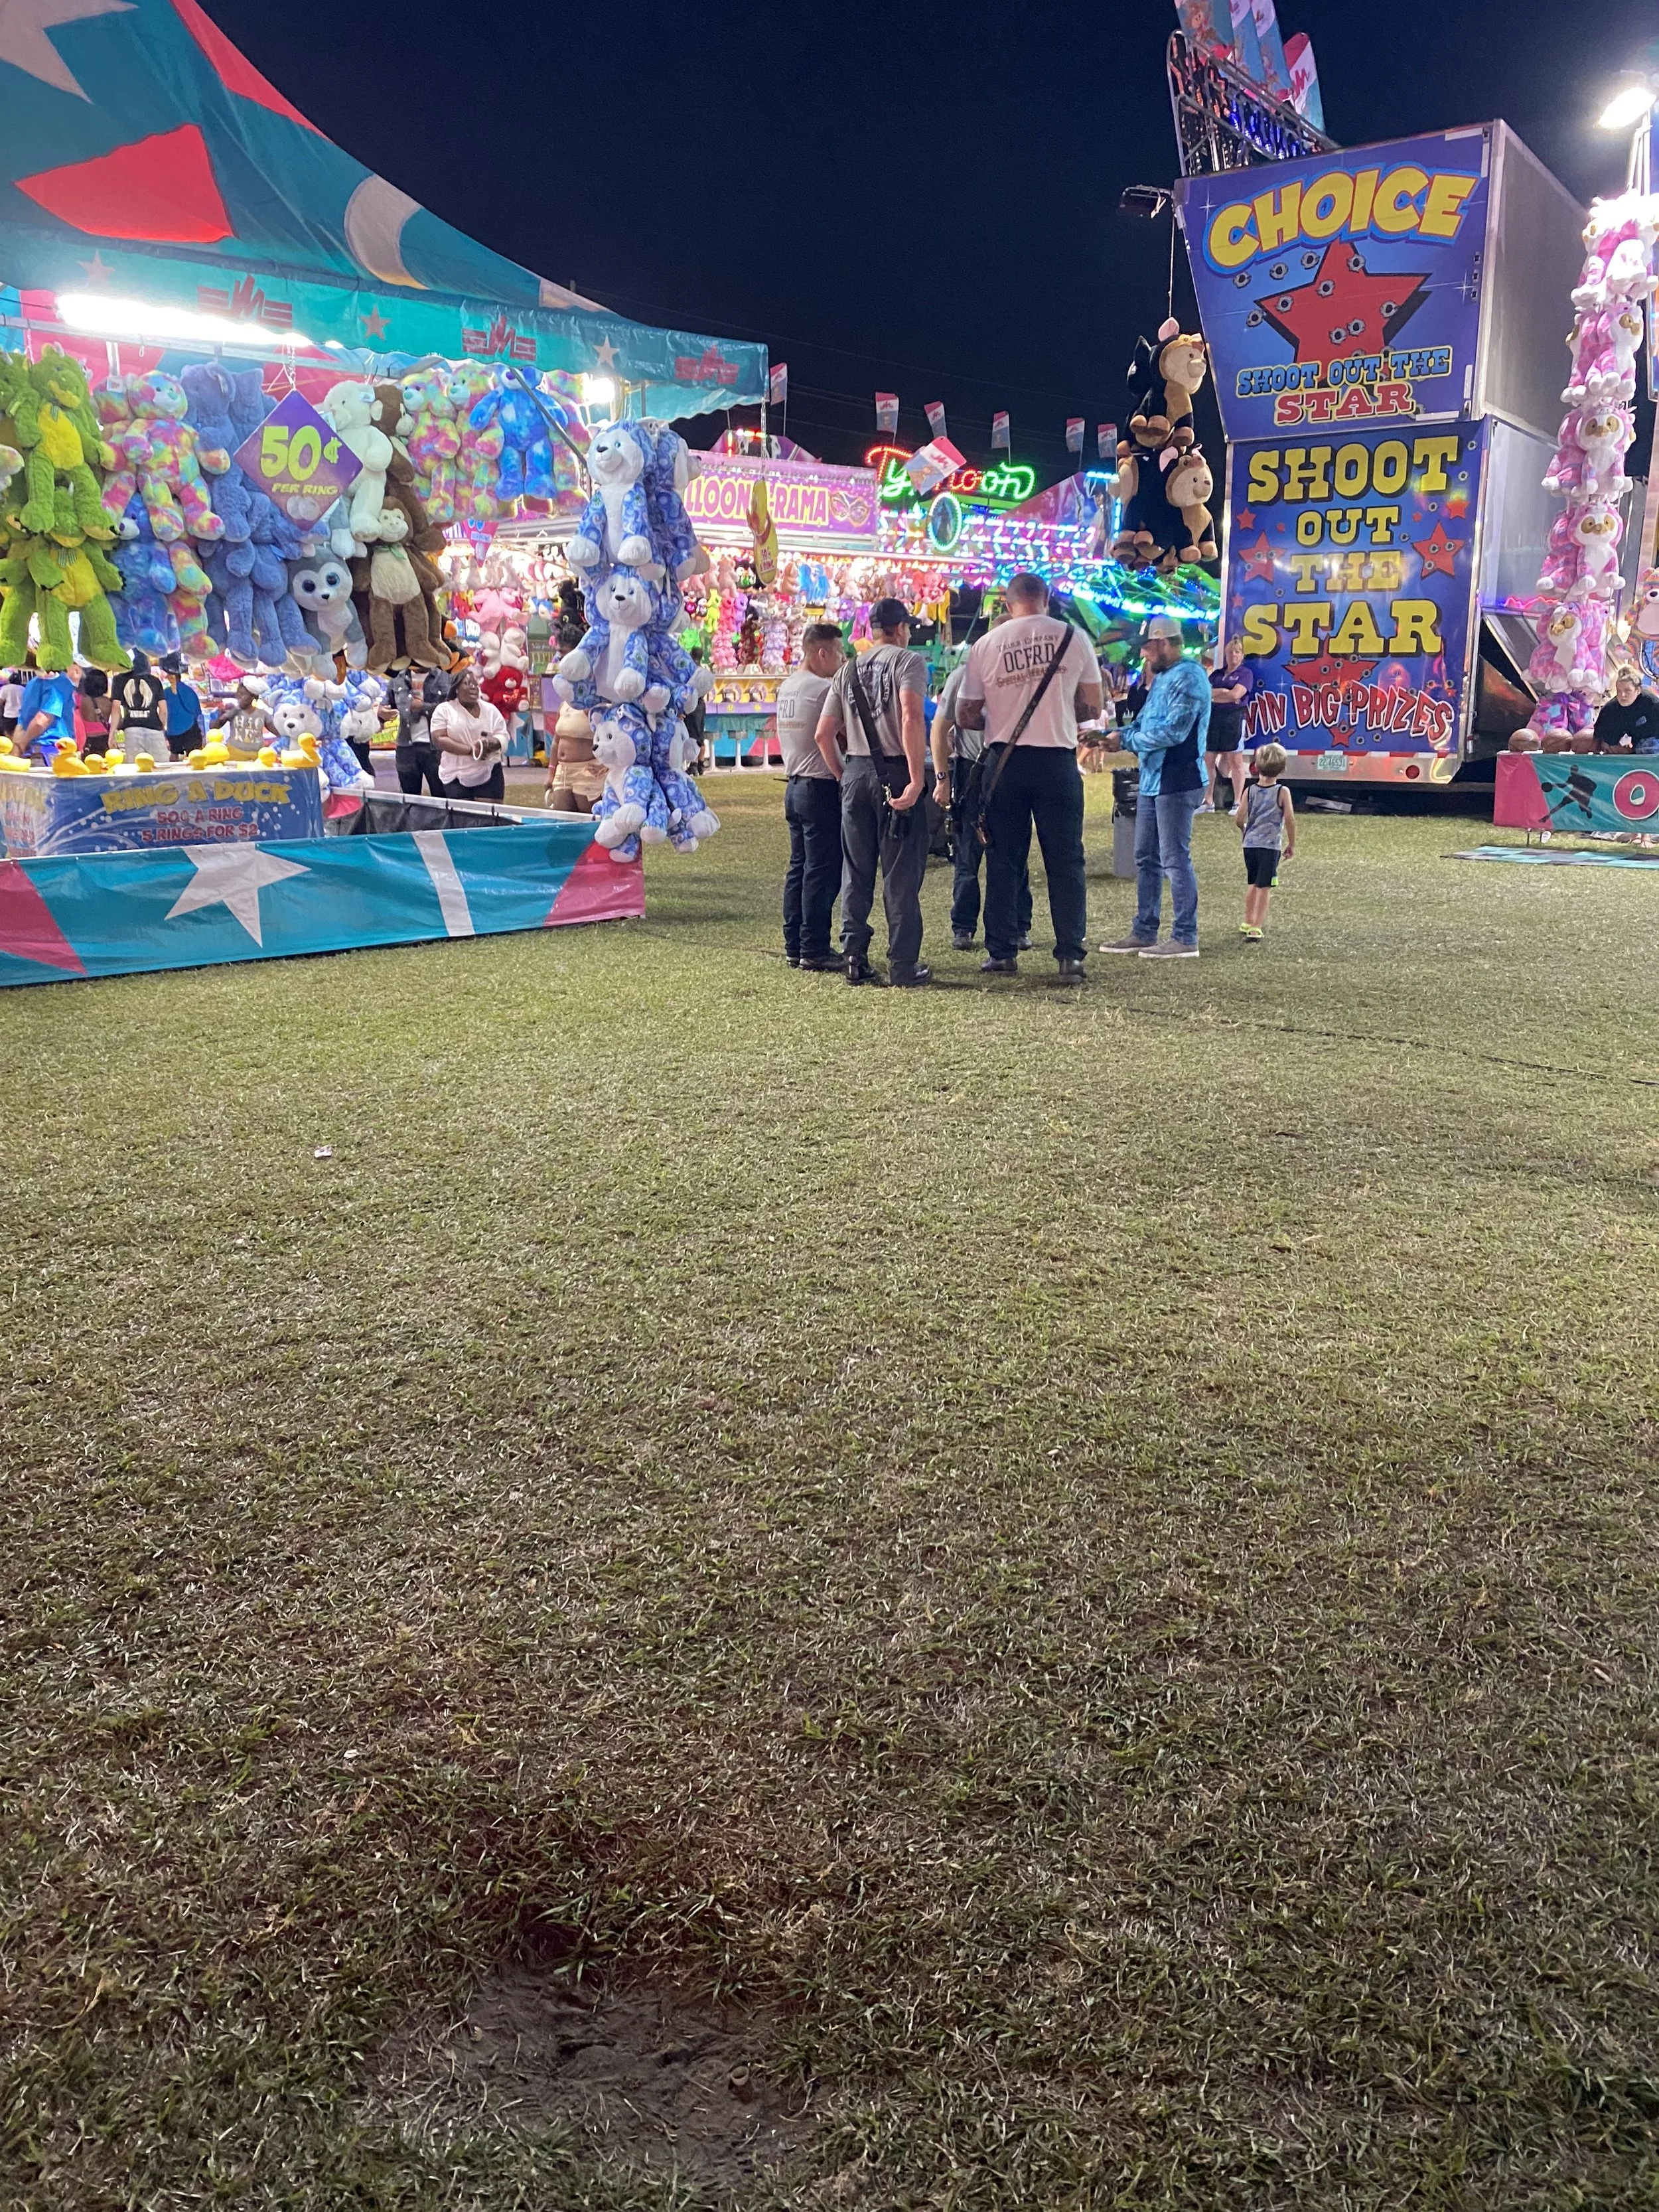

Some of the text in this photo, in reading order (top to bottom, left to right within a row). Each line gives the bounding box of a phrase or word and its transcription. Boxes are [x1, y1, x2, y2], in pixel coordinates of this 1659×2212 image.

[1208, 166, 1477, 268] CHOICE
[1237, 348, 1451, 396] SHOOT OUT THE
[1275, 383, 1415, 425] STAR
[271, 482, 338, 495] PER RING
[1248, 435, 1458, 503] SHOOT
[1296, 506, 1400, 547] OUT
[1291, 550, 1404, 593] THE
[1024, 634, 1060, 645] COMPANY
[1242, 599, 1442, 656] STAR
[1003, 642, 1055, 673] OCFRD
[1291, 684, 1342, 729] BIG
[1348, 680, 1455, 743] PRIZES
[101, 780, 291, 814] RING A DUCK
[195, 808, 206, 822] A
[208, 806, 244, 821] RING
[142, 823, 259, 842] 5 RINGS FOR $2
